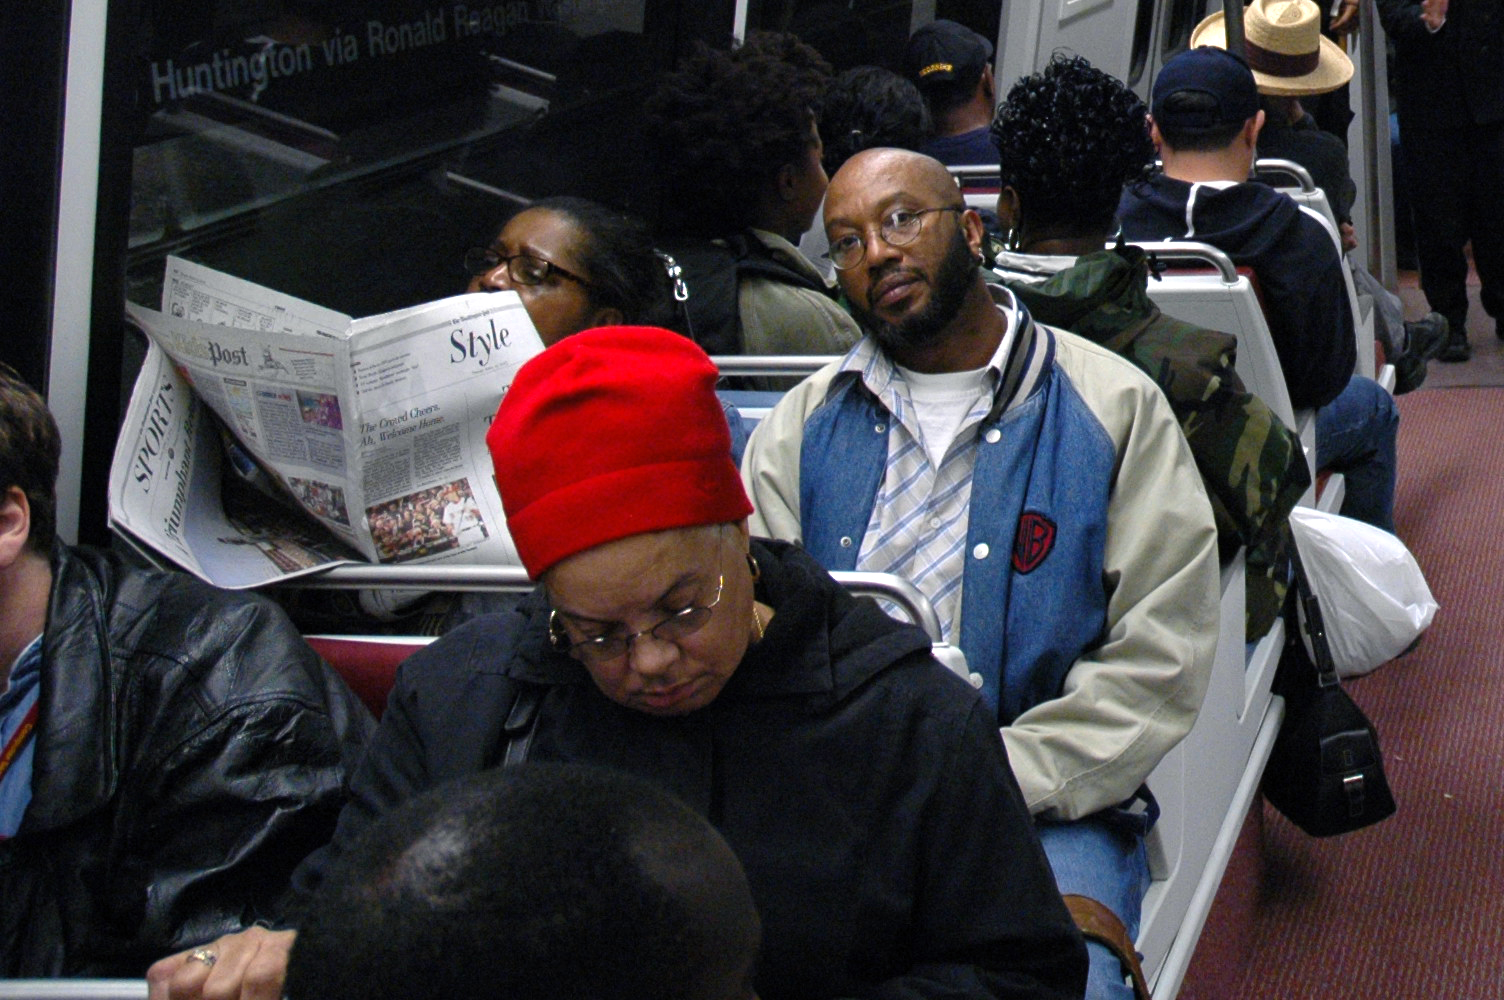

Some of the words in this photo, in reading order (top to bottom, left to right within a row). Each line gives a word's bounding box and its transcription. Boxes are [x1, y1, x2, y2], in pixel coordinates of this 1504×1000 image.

[150, 42, 313, 103] Huntington
[321, 28, 359, 67] via
[367, 10, 447, 58] Ronald
[453, 0, 529, 39] Reagan
[450, 318, 512, 367] Style
[360, 422, 378, 435] The
[379, 410, 408, 428] Crowd
[379, 425, 417, 442] Welcome
